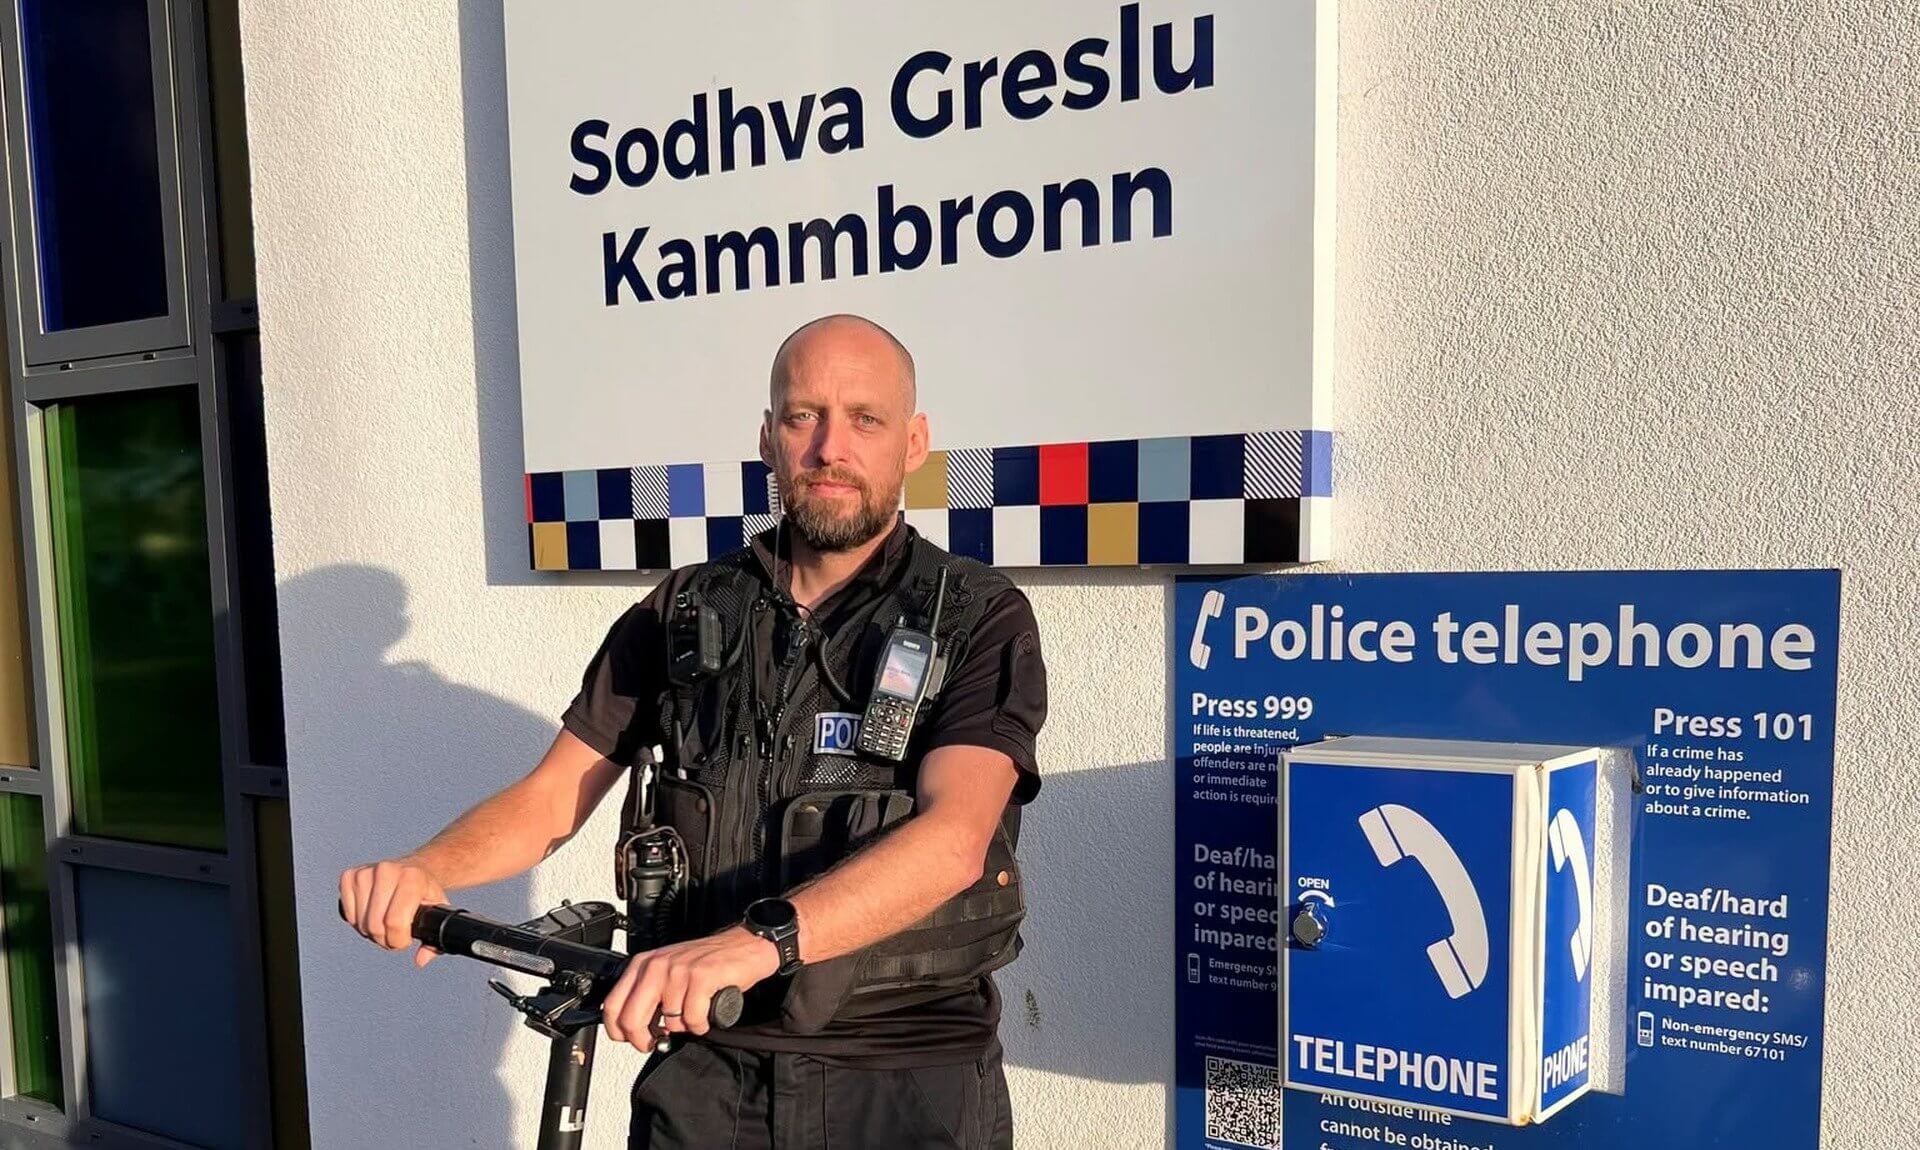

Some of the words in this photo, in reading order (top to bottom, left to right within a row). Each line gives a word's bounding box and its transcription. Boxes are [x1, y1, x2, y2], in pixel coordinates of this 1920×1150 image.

[569, 86, 865, 195] Sodhva
[890, 1, 1216, 139] Greslu
[602, 166, 1174, 307] Kammbronn
[1234, 604, 1416, 663] Police
[1432, 604, 1816, 682] telephone
[1191, 692, 1258, 719] Press
[1263, 696, 1313, 721] 999
[1193, 723, 1202, 735] If
[1203, 724, 1220, 736] life
[1222, 726, 1231, 737] is
[1233, 725, 1299, 741] threatened,
[1654, 708, 1742, 738] Press
[1754, 712, 1812, 741] 101
[1193, 741, 1232, 754] people
[1233, 745, 1252, 754] are
[1647, 744, 1658, 757] If
[1660, 748, 1668, 757] a
[1672, 746, 1714, 760] crime
[1718, 747, 1743, 761] has
[1193, 756, 1245, 770] offenders
[1247, 762, 1265, 771] are
[1646, 763, 1700, 781] already
[1705, 766, 1782, 783] happened
[1193, 775, 1205, 783] or
[1207, 773, 1267, 788] immediate
[1193, 789, 1227, 801] action
[1230, 790, 1239, 802] is
[1646, 785, 1661, 795] or
[1665, 785, 1680, 796] to
[1683, 785, 1715, 800] give
[1719, 786, 1809, 804] information
[1645, 801, 1689, 816] about
[1692, 806, 1700, 816] a
[1704, 805, 1750, 819] crime.
[1194, 843, 1276, 869] Deaf/ha
[1194, 871, 1216, 890] of
[1298, 876, 1329, 890] OPEN
[1194, 902, 1216, 917] or
[1220, 904, 1279, 925] speec
[1646, 884, 1787, 918] Deaf/hard
[1645, 916, 1675, 939] of
[1680, 917, 1789, 956] hearing
[1209, 958, 1265, 976] Emergency
[1645, 951, 1674, 969] or
[1680, 954, 1778, 982] speech
[1209, 974, 1229, 985] text
[1229, 978, 1269, 991] number
[1644, 976, 1769, 1013] impared:
[1662, 1018, 1770, 1045] Non-emergency
[1773, 1032, 1808, 1048] SMS/
[1661, 1035, 1687, 1047] text
[1690, 1040, 1741, 1055] number
[1744, 1045, 1785, 1061] 67101
[1293, 1034, 1498, 1101] TELEPHONE
[1544, 1034, 1588, 1094] PHONE
[1320, 1093, 1344, 1107] An
[1348, 1098, 1414, 1119] outside
[1320, 1119, 1380, 1142] cannot
[1385, 1126, 1407, 1146] be
